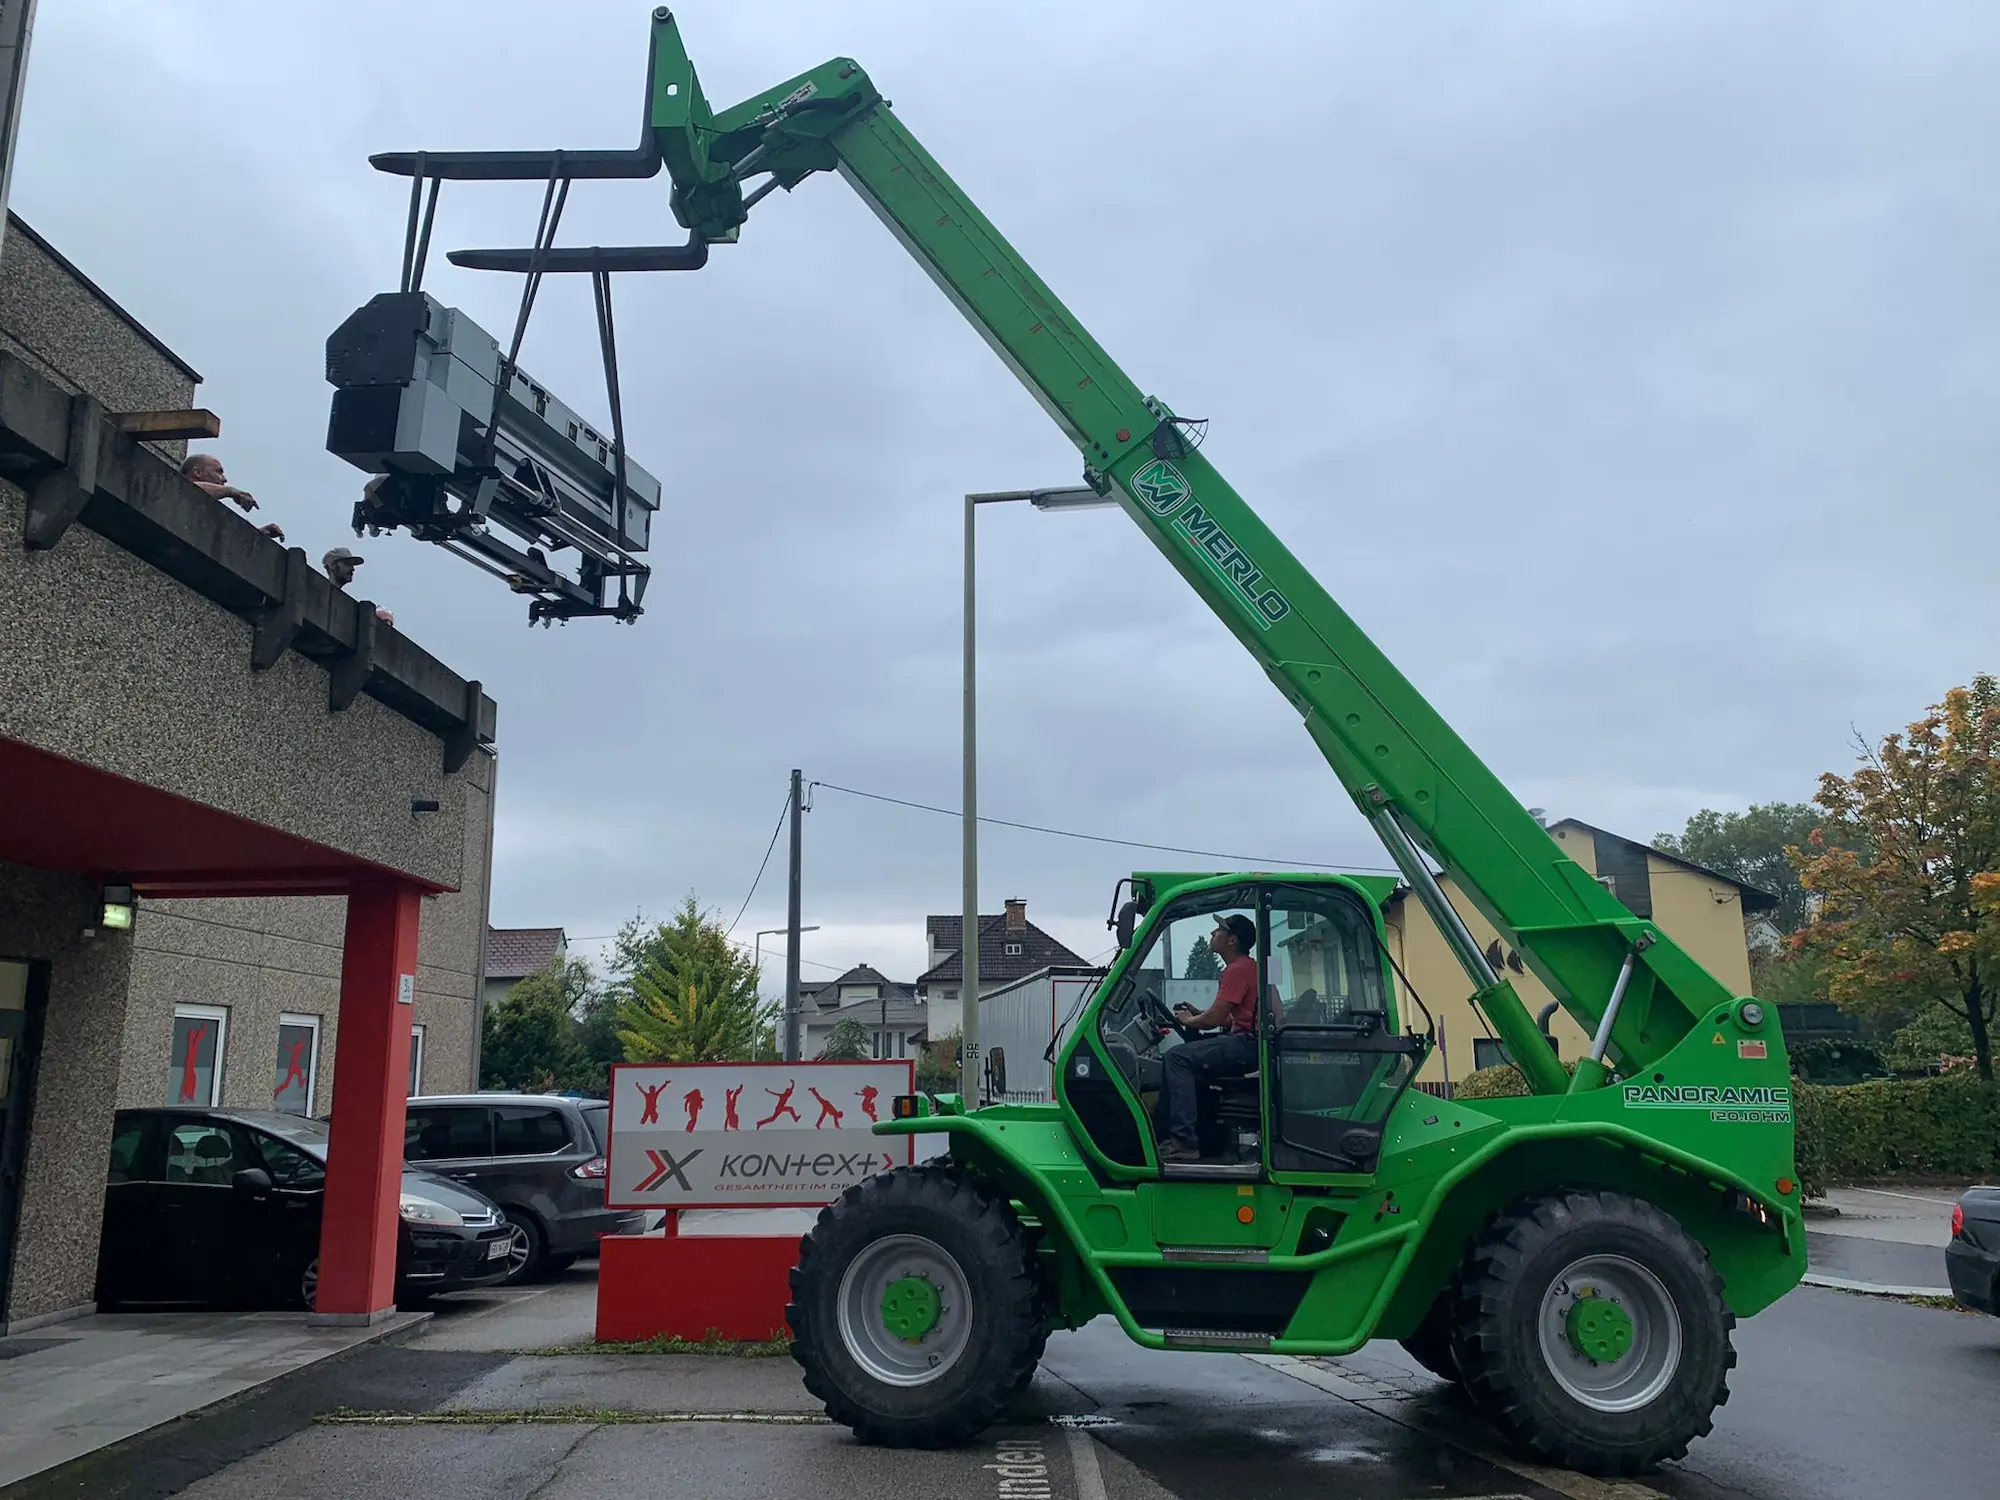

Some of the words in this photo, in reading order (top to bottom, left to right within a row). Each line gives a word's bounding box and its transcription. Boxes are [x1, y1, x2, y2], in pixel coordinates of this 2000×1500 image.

[1179, 502, 1290, 622] MERLO
[1623, 1086, 1788, 1104] PANORAMIC
[714, 1183, 807, 1192] GESAMTHEIT
